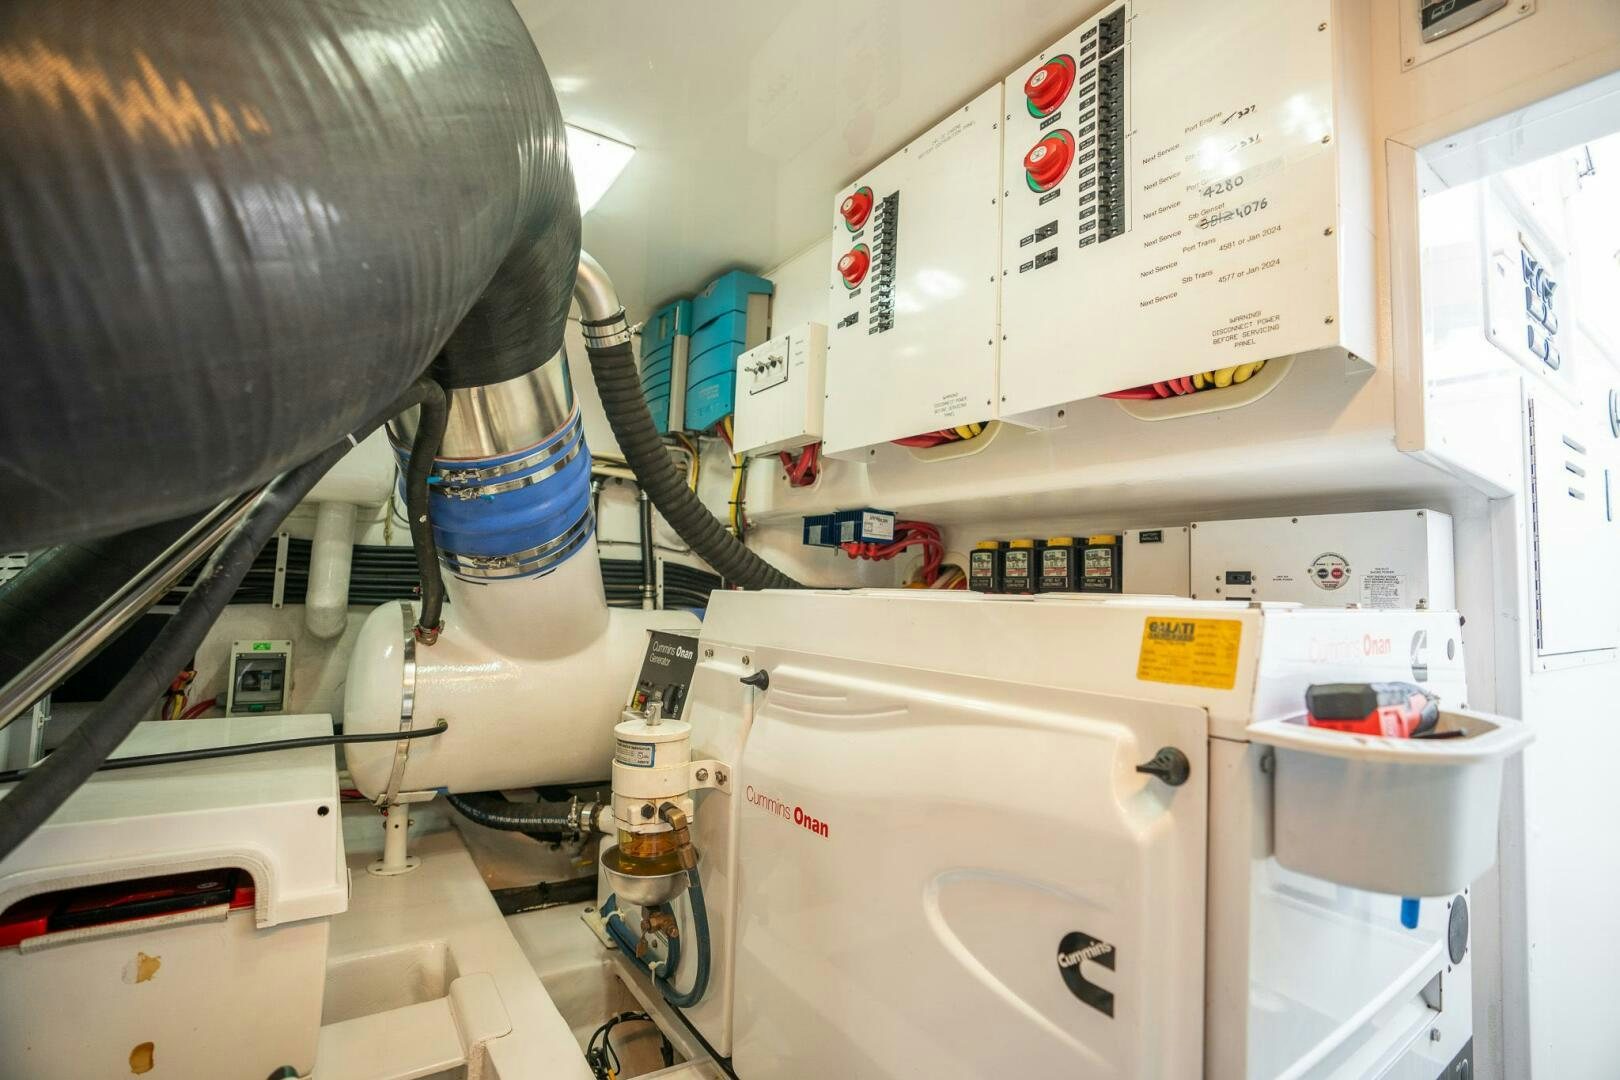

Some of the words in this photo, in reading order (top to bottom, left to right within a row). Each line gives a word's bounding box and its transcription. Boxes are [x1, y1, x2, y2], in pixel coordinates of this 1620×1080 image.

[1184, 124, 1198, 134] Port
[1199, 111, 1222, 127] Engine
[1142, 154, 1156, 165] Next
[1157, 143, 1180, 158] Service
[1144, 181, 1158, 192] Next
[1158, 171, 1181, 185] Service
[1203, 175, 1244, 198] 4280
[1143, 210, 1158, 220] Next
[1158, 200, 1181, 216] Service
[1188, 212, 1200, 221] Stb
[1201, 202, 1225, 216] Genset
[1236, 198, 1268, 218] 4076
[1144, 238, 1158, 248] Next
[1158, 230, 1182, 243] Service
[1182, 243, 1196, 254] Port
[1198, 237, 1216, 248] Trans
[1218, 240, 1236, 252] 4581
[1238, 238, 1246, 246] or
[1247, 233, 1260, 242] Jan
[1262, 224, 1282, 236] 2024
[1140, 267, 1154, 278] Next
[1155, 260, 1178, 273] Service
[1182, 275, 1193, 285] Stb
[1194, 269, 1214, 282] Trans
[1218, 273, 1236, 284] 4577
[1236, 270, 1245, 278] or
[1246, 266, 1260, 276] Jan
[1261, 258, 1280, 270] 2024
[1140, 298, 1154, 308] Next
[1155, 291, 1178, 304] Service
[1212, 322, 1253, 336] DISCONNECT
[1256, 314, 1280, 326] POWER
[1212, 334, 1239, 344] BEFORE
[1242, 324, 1280, 338] SERVICING
[1234, 338, 1256, 348] PANEL
[652, 640, 676, 656] Cummins
[676, 646, 694, 660] Onan
[1363, 634, 1392, 656] Onan
[650, 652, 671, 666] Generator
[746, 785, 790, 820] Cummins
[794, 806, 828, 838] Onan
[1058, 941, 1112, 968] Cummins
